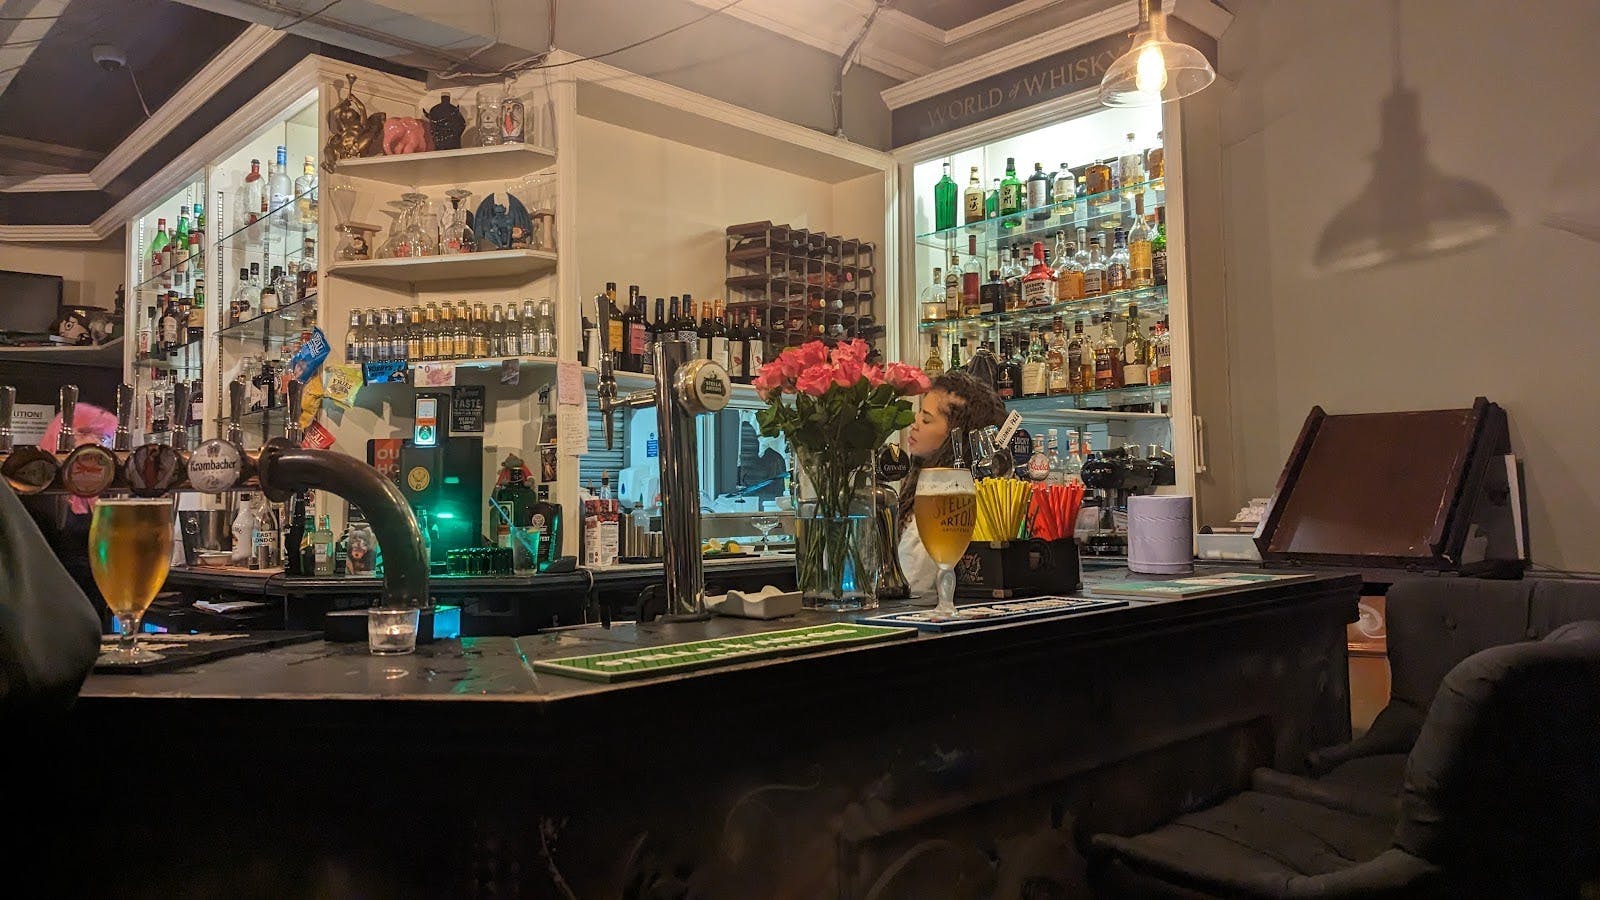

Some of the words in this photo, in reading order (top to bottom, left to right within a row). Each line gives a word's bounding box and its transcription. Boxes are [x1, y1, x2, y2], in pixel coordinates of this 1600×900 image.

[927, 88, 1004, 129] WORLD
[1008, 81, 1020, 99] of
[454, 399, 482, 408] TASTE
[1014, 436, 1030, 445] LUCKY
[1014, 444, 1030, 454] SAINT
[190, 459, 236, 472] Krombacher
